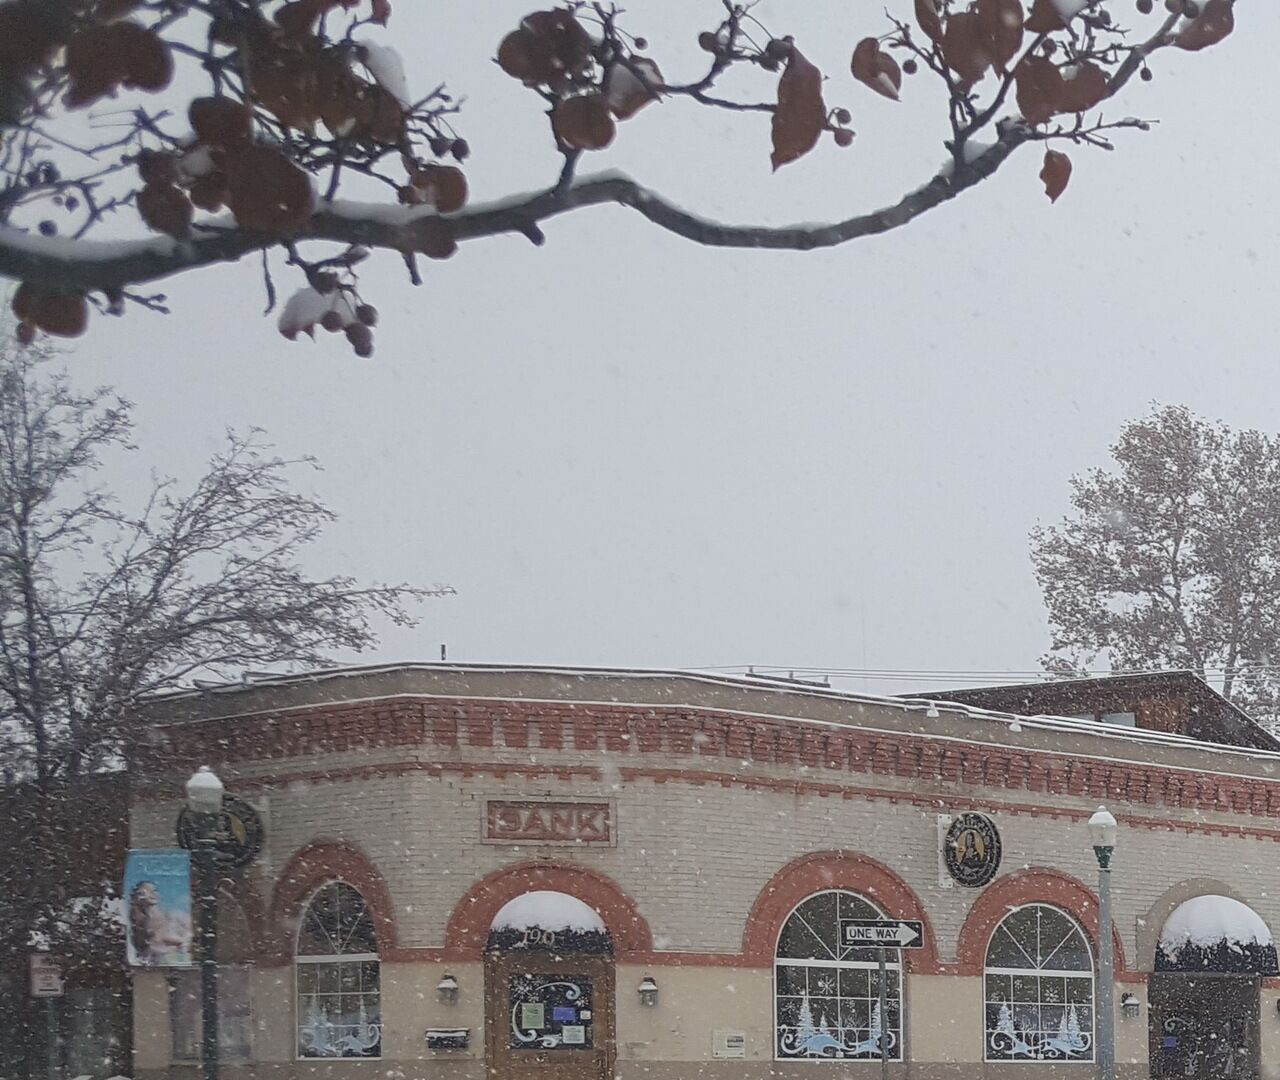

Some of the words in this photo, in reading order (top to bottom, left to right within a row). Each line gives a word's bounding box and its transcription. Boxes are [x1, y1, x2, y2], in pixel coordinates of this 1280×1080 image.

[497, 806, 601, 834] BANK
[849, 927, 873, 939] ONE
[875, 927, 900, 939] WAY
